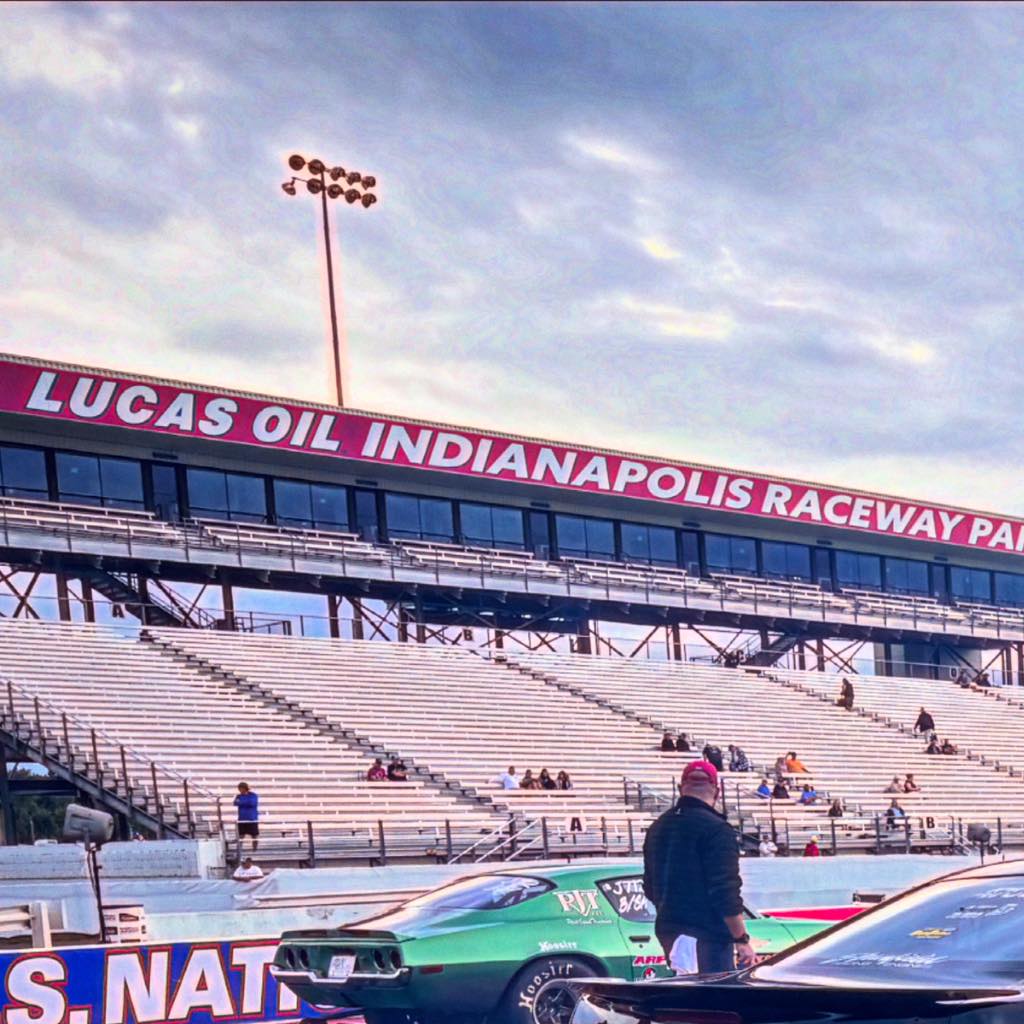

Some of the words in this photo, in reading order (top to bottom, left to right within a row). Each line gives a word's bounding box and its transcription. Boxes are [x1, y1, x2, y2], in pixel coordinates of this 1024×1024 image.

[26, 371, 239, 436] LUCAS
[252, 405, 341, 452] OIL
[361, 421, 753, 509] INDIANAPOLIS
[761, 483, 964, 541] RACEWAY
[462, 629, 473, 641] B
[569, 817, 582, 831] A
[927, 816, 936, 829] B
